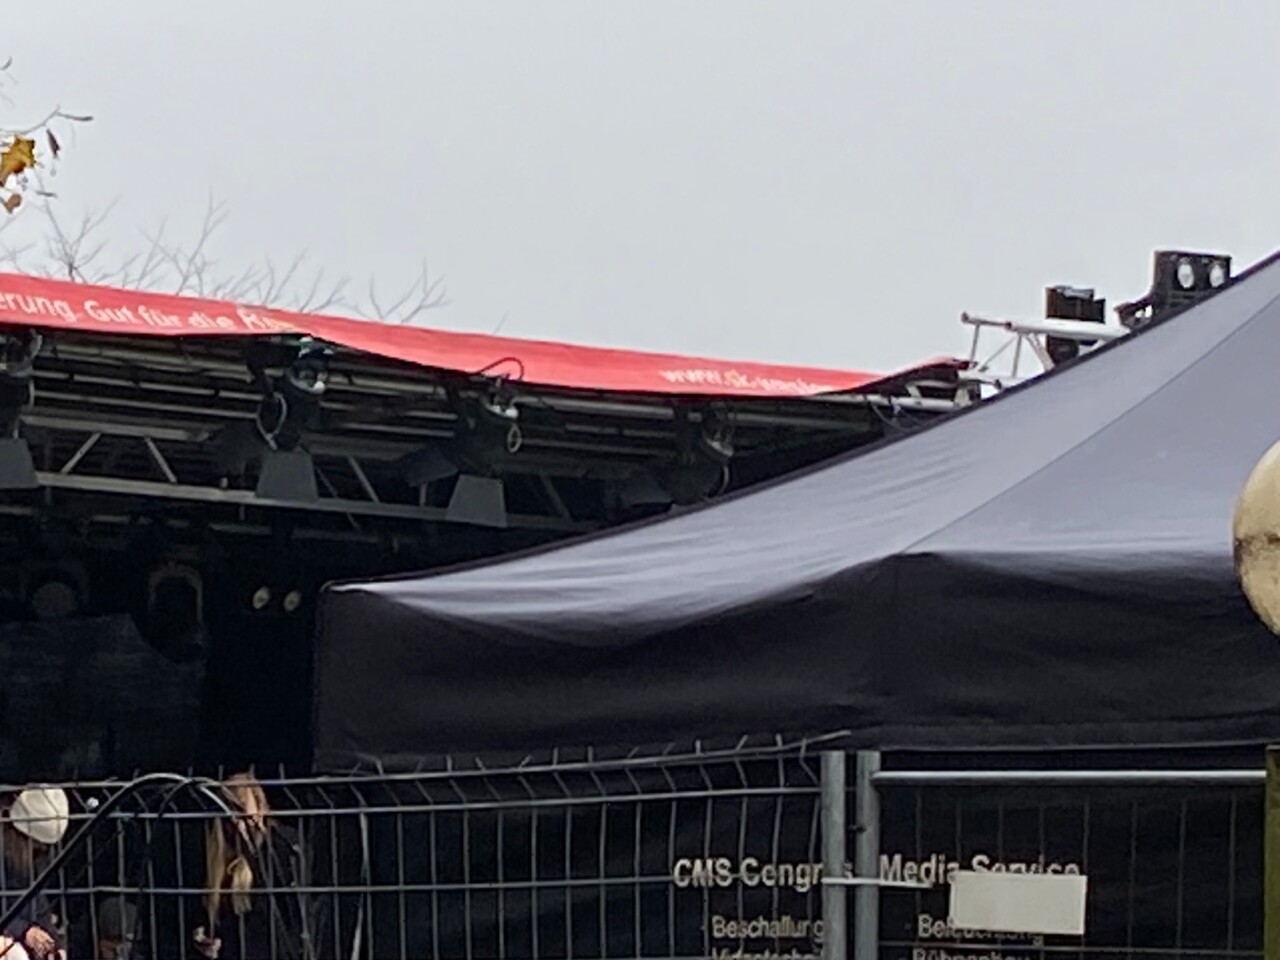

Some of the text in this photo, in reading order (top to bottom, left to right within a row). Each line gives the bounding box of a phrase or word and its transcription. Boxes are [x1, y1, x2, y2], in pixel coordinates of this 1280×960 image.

[84, 300, 141, 324] Gut
[673, 858, 733, 888] CMS
[740, 857, 855, 893] Congr
[880, 853, 959, 884] Media
